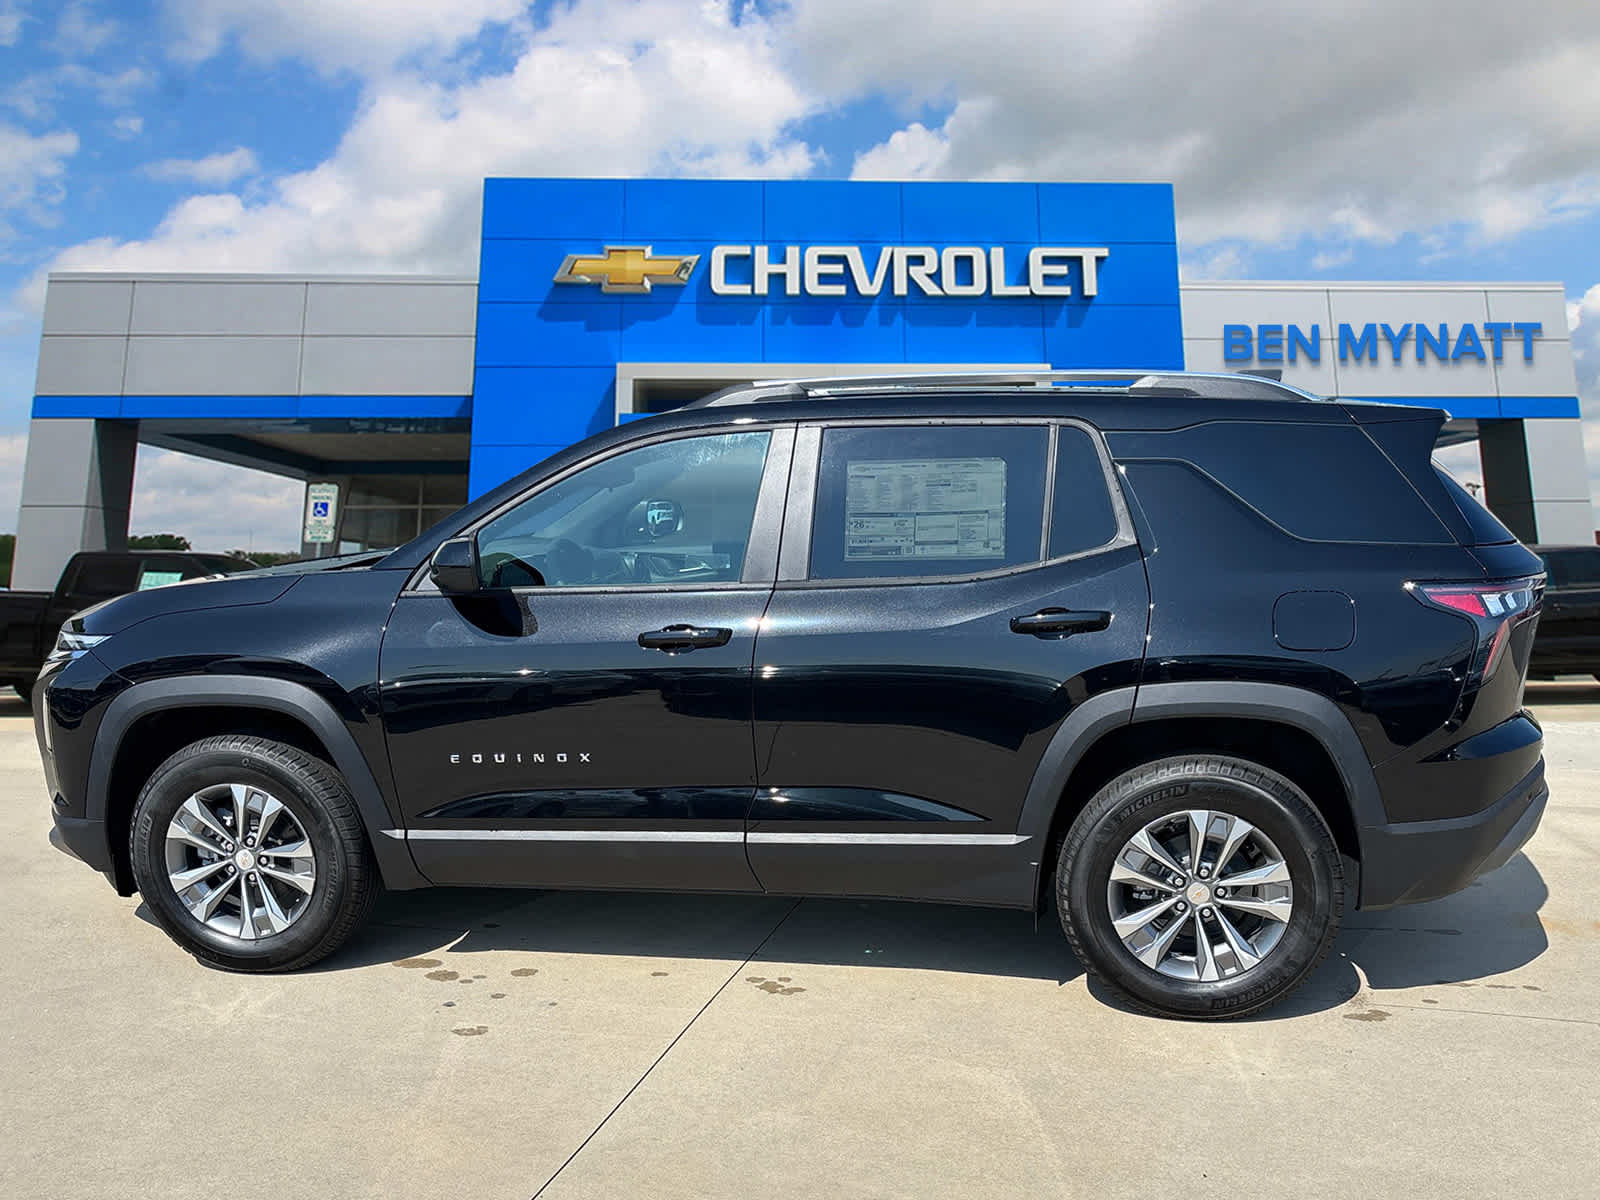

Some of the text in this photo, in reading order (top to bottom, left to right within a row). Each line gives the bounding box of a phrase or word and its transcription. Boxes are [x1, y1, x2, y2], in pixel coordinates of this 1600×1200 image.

[710, 244, 1109, 297] CHEVROLET
[1223, 321, 1542, 363] BEN MYNATT
[449, 752, 591, 764] EQUINOX
[1119, 785, 1187, 821] MICHELIN
